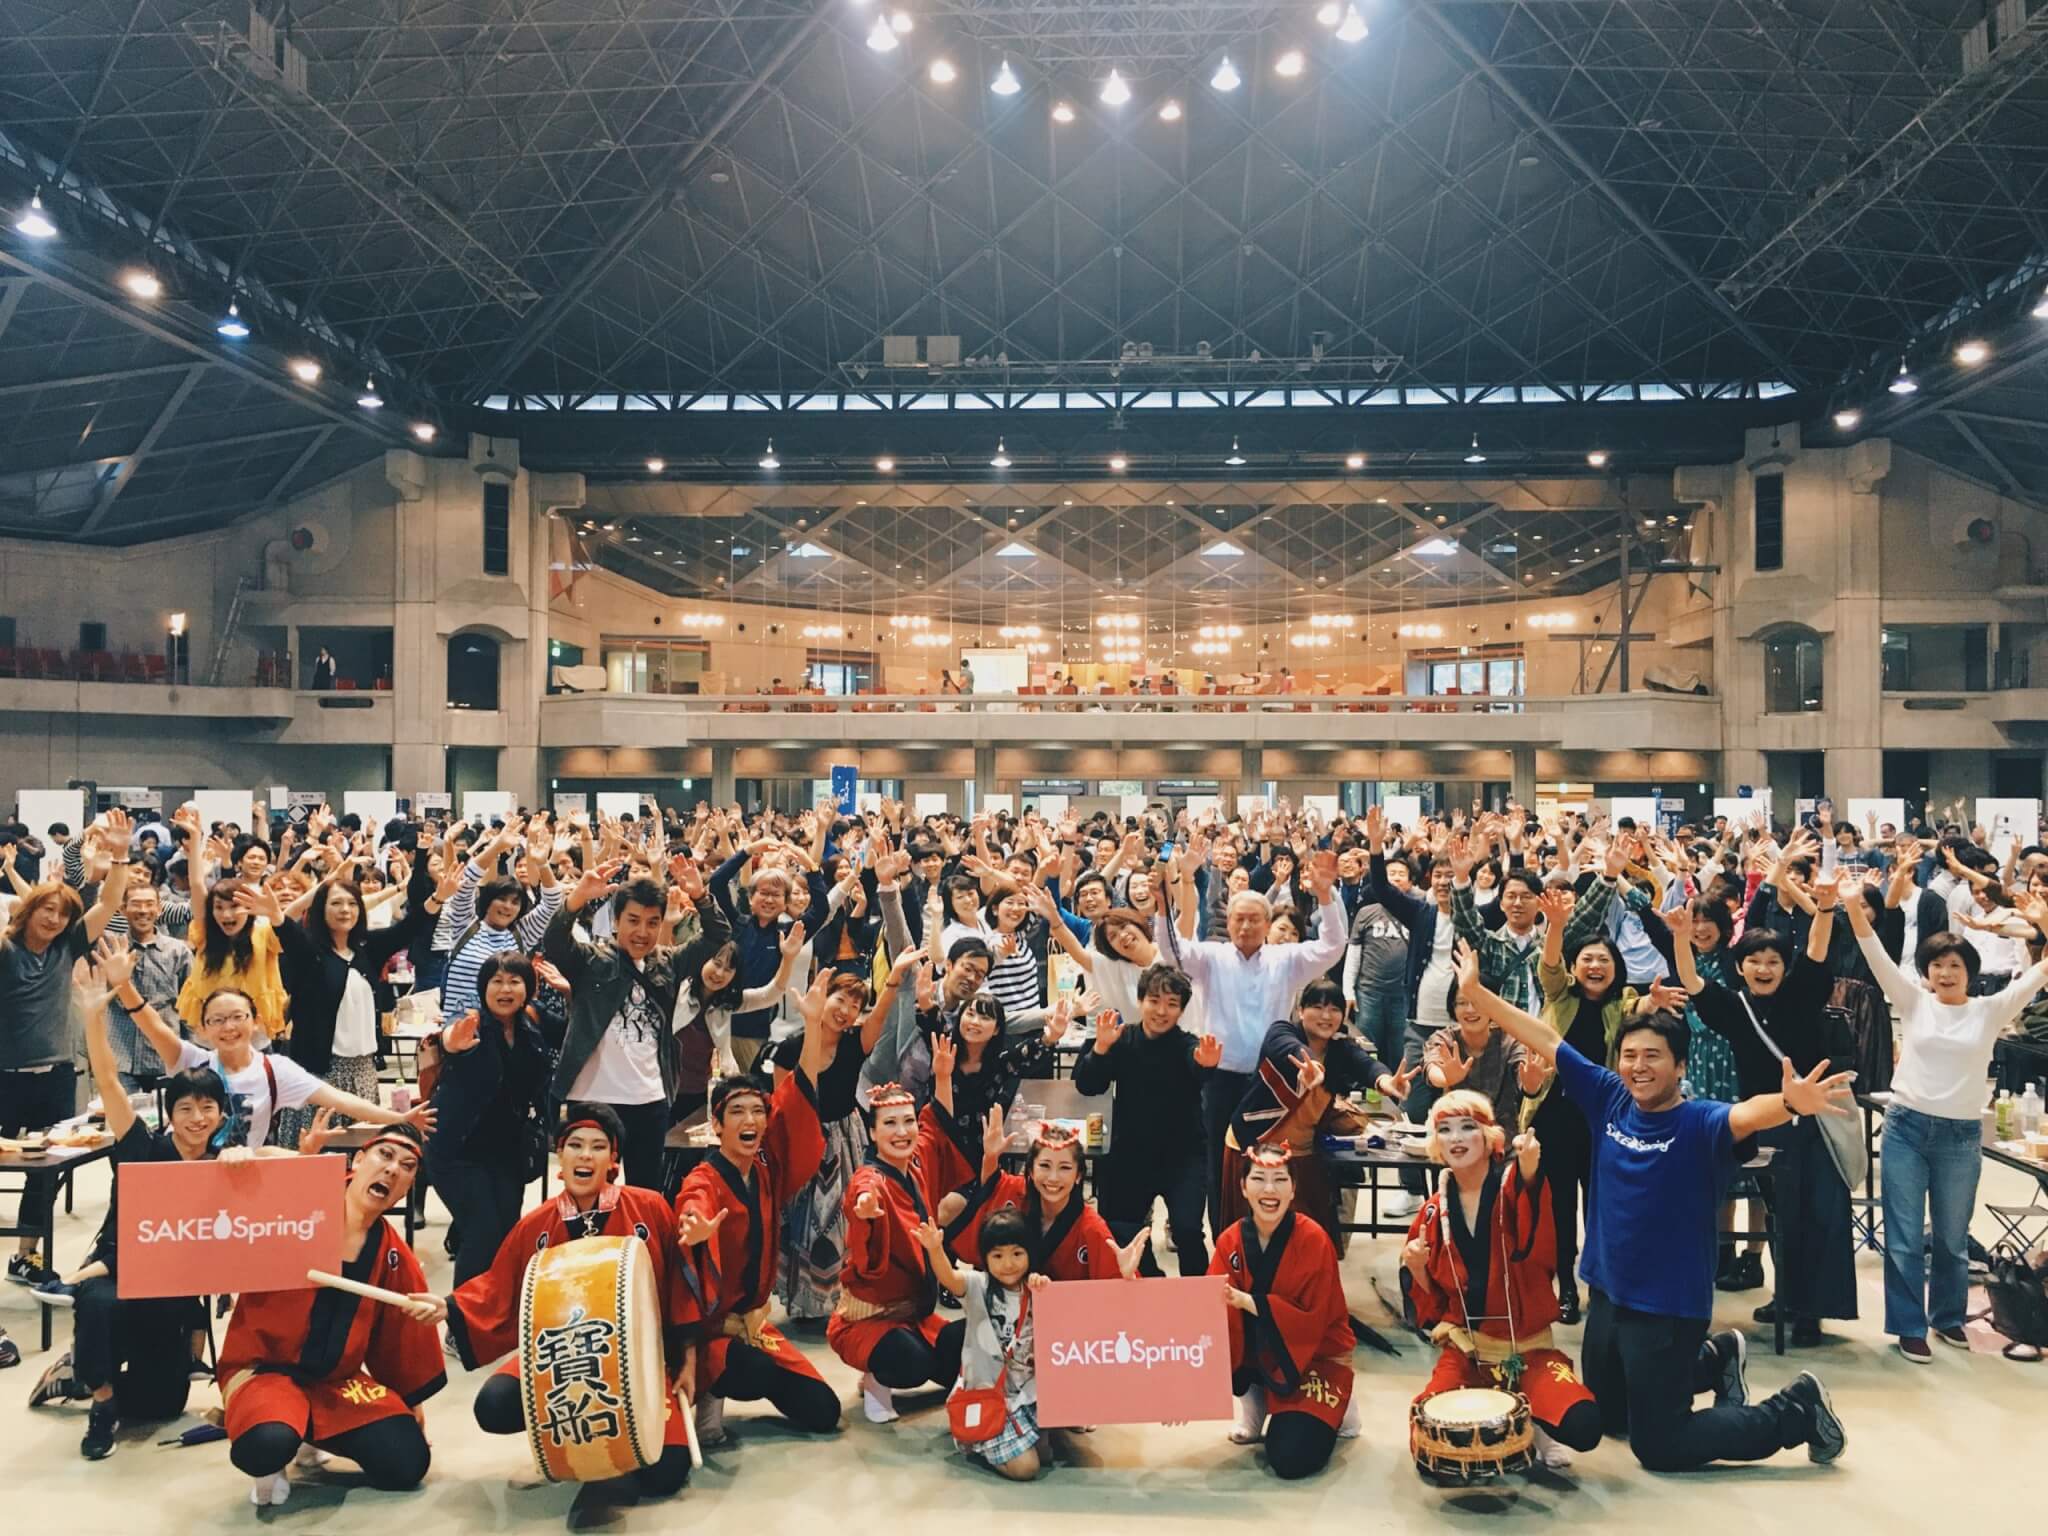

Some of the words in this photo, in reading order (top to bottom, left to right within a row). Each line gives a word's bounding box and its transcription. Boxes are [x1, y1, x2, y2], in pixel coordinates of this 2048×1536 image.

[137, 1217, 213, 1243] SAKE
[232, 1213, 315, 1245] Spring
[1050, 1339, 1116, 1366] SAKE
[1131, 1338, 1205, 1369] Spring
